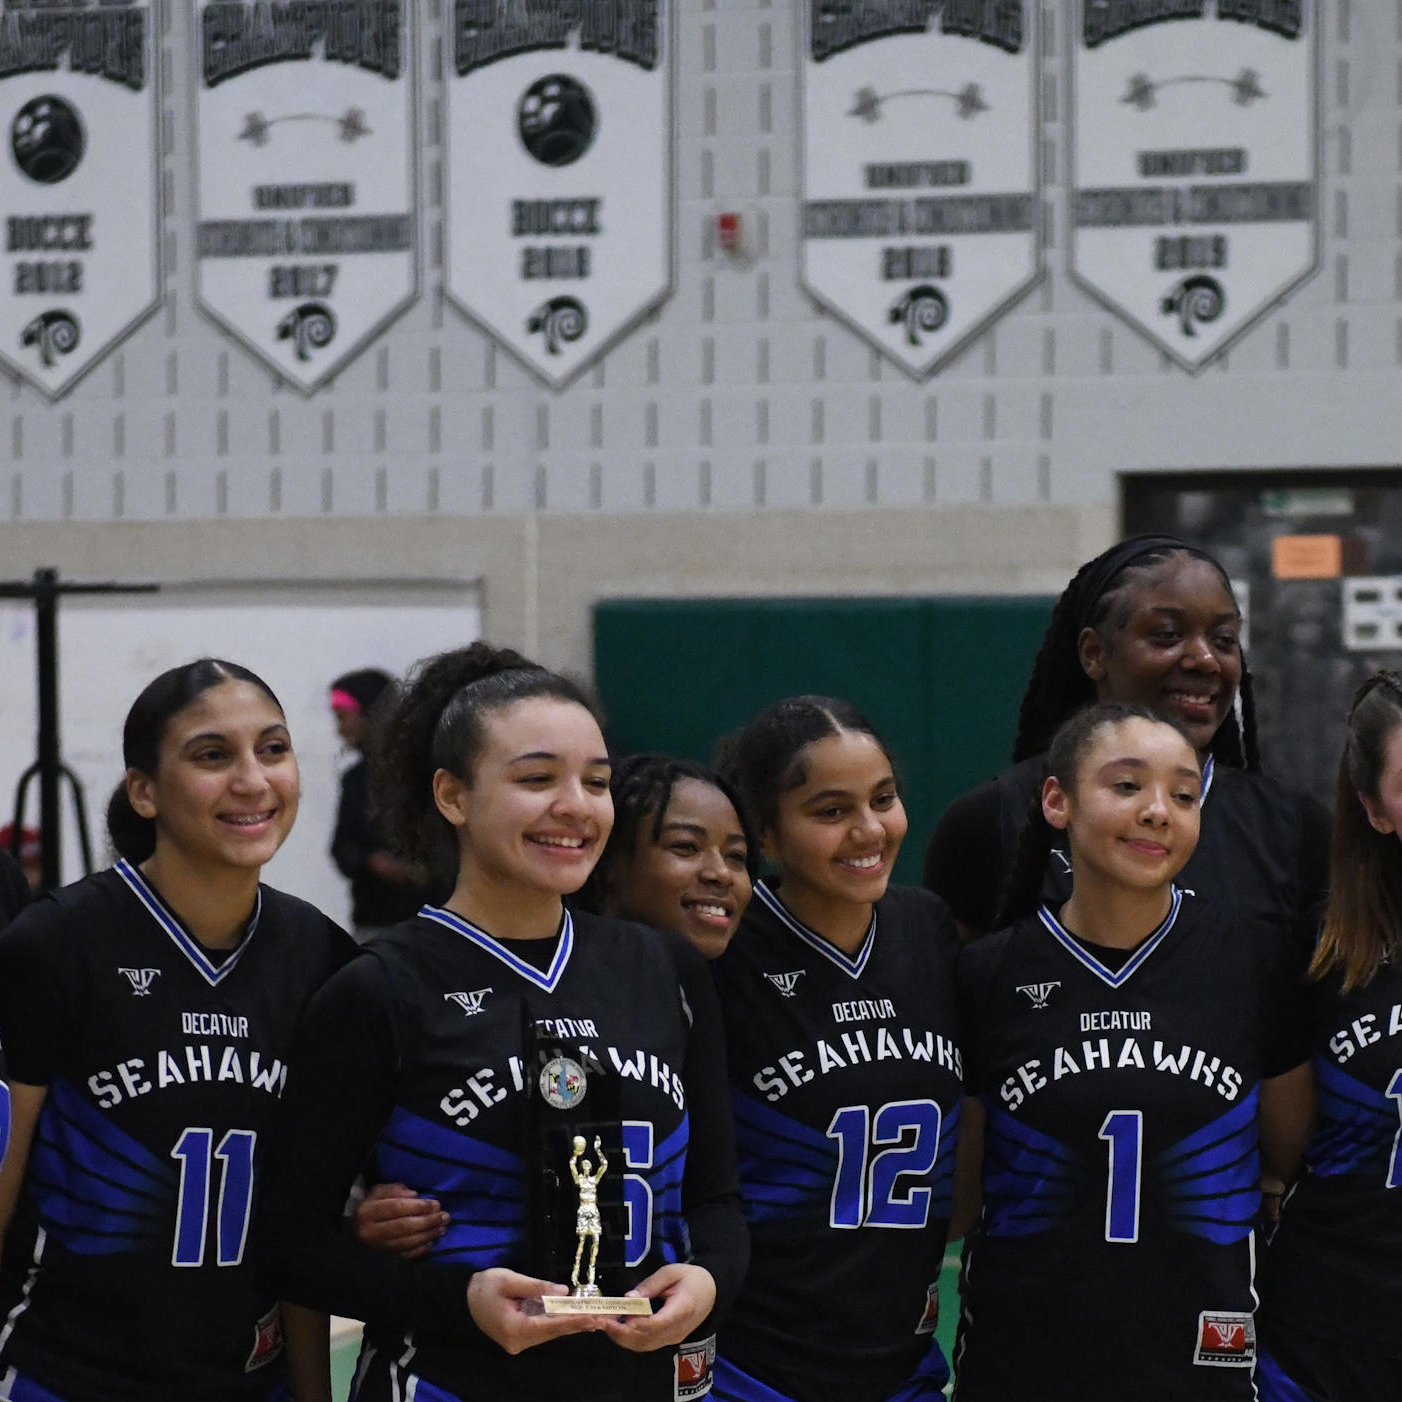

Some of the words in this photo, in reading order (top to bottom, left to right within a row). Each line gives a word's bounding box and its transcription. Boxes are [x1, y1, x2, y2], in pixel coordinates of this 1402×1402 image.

[182, 1012, 248, 1038] DECATUR
[832, 998, 897, 1023] DECATUR
[1080, 1011, 1152, 1032] DECATUR
[753, 1027, 964, 1101] SEAHAWKS
[1000, 1038, 1243, 1111] SEAHAWKS
[170, 1127, 258, 1268] 11
[826, 1099, 941, 1229] 12
[1098, 1110, 1143, 1243] 1
